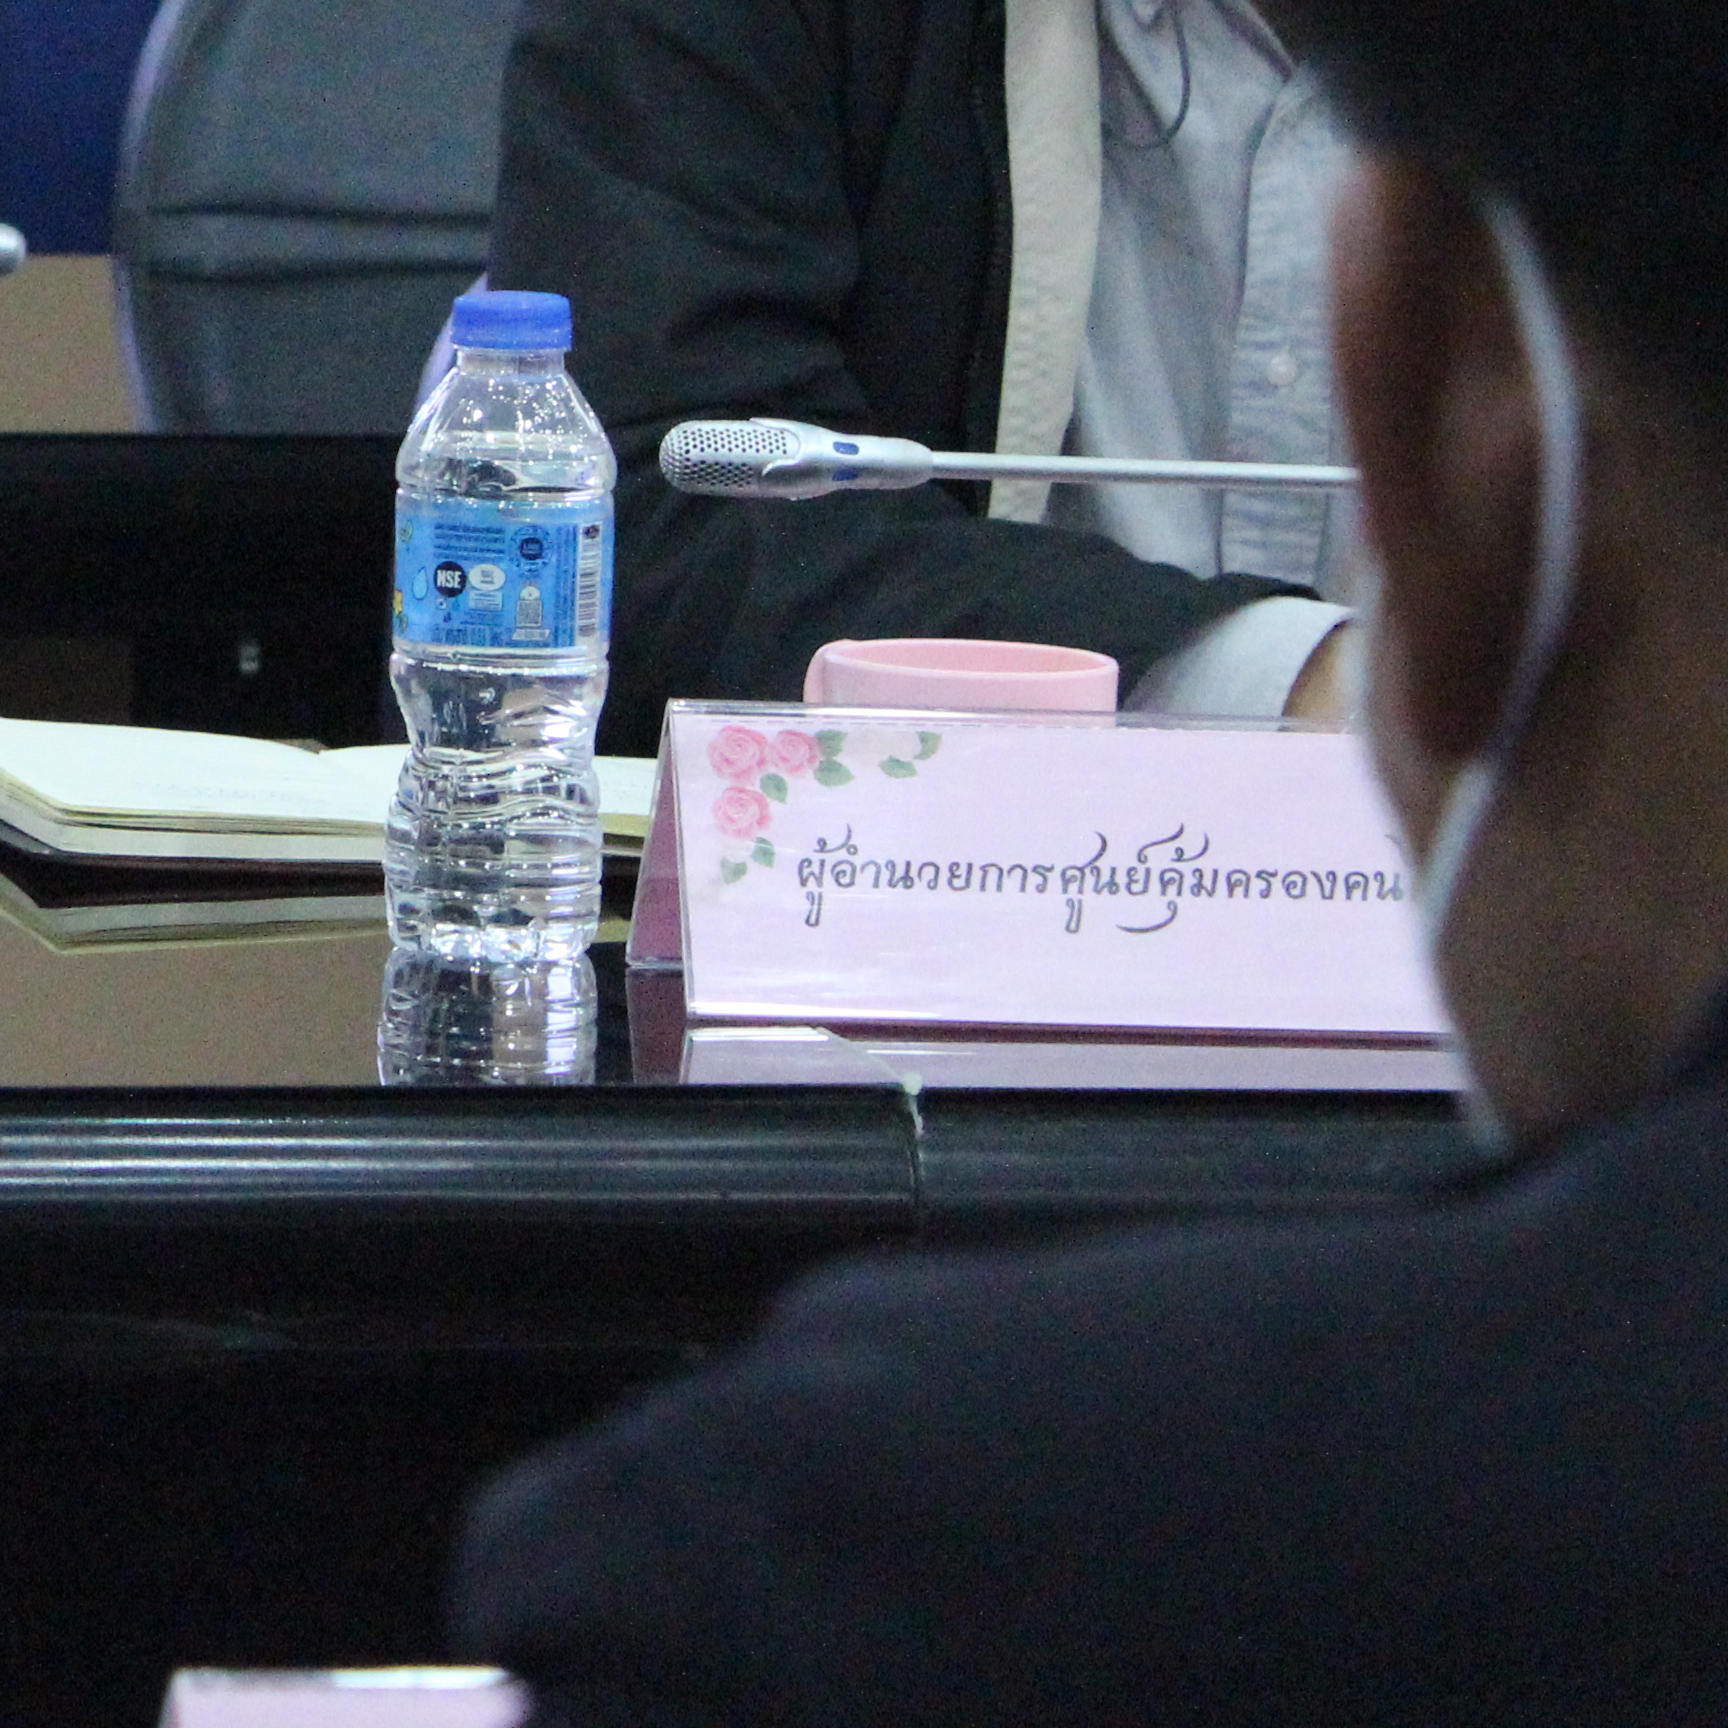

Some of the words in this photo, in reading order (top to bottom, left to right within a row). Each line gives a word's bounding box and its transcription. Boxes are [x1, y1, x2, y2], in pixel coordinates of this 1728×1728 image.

[797, 823, 1404, 934] ผู้อำนวยการศูนย์คุ้มครองคน
